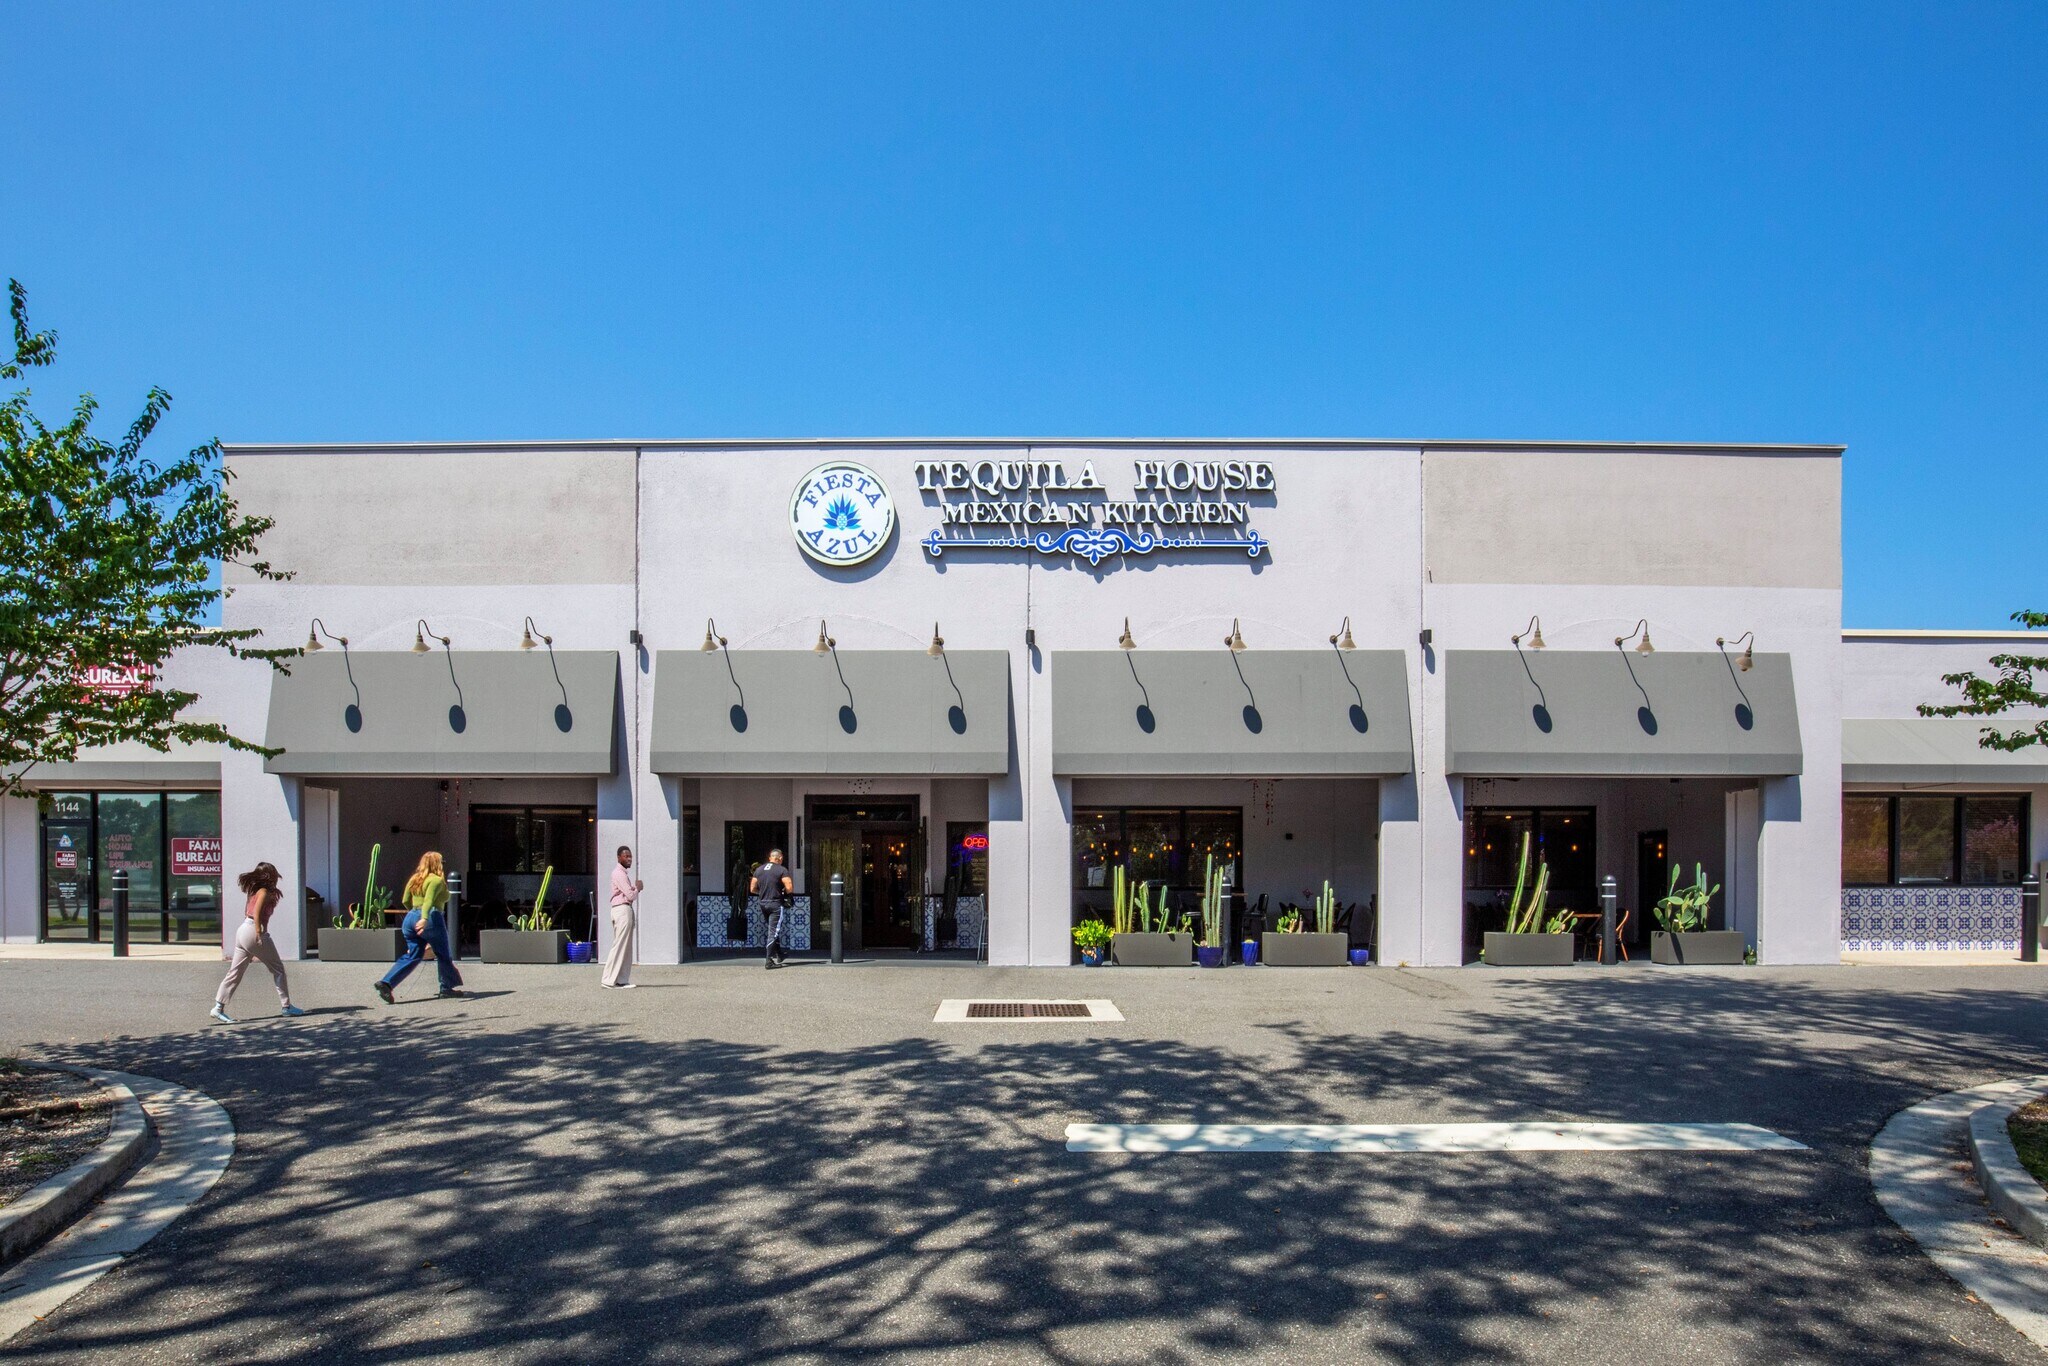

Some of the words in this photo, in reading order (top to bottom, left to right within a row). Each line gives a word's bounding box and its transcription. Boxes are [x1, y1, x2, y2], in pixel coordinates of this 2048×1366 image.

[914, 460, 1106, 495] TEQUILA
[1134, 460, 1275, 490] HOUSE
[803, 473, 882, 509] FIESTA
[941, 501, 1091, 524] MEXICAN
[1102, 501, 1246, 524] KITCHEN
[806, 529, 878, 555] AZUL
[55, 802, 79, 812] 1144
[109, 834, 132, 842] AUTO
[108, 843, 133, 851] HOME
[188, 841, 221, 850] FARM
[175, 852, 221, 862] BUREAU
[109, 861, 153, 869] INSURANCE
